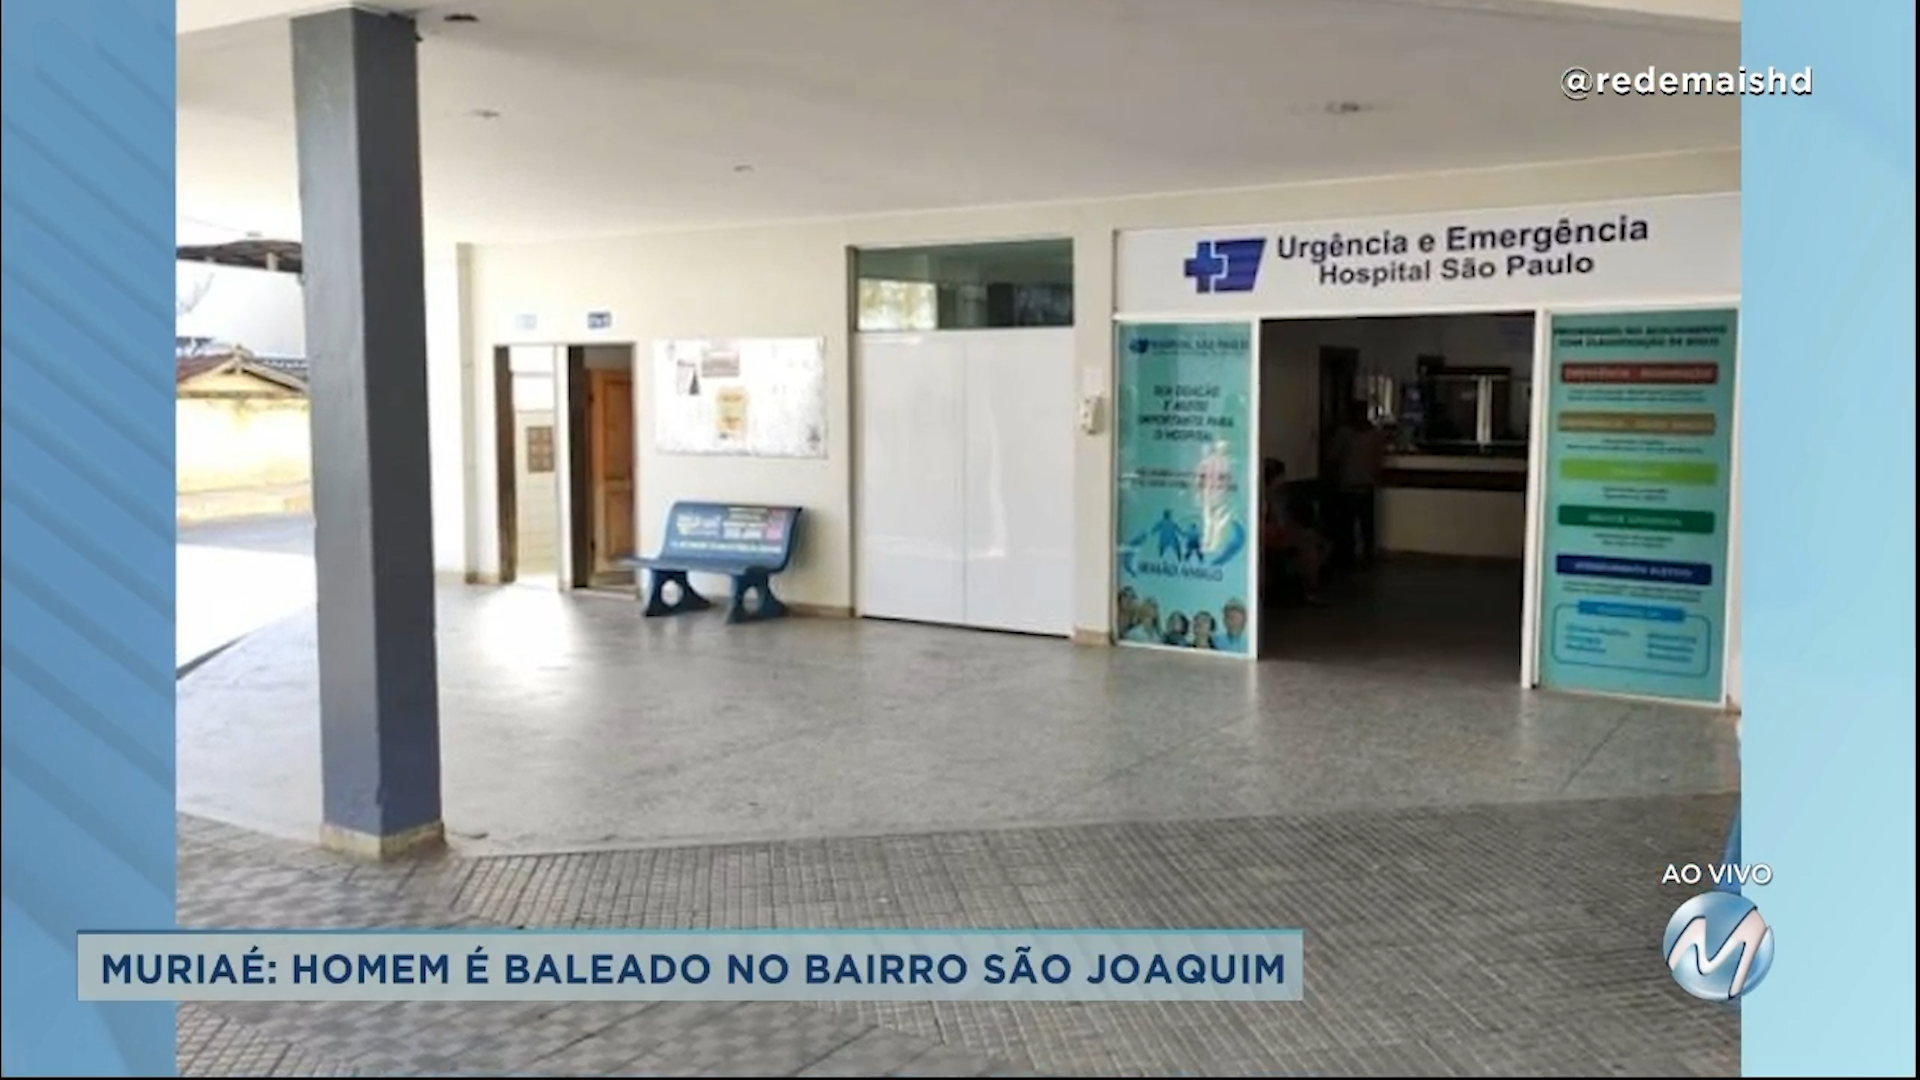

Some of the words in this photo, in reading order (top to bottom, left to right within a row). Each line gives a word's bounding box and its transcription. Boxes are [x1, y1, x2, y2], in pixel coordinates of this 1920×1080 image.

[1276, 231, 1409, 263] Urgência
[1418, 234, 1436, 253] e
[1446, 215, 1649, 253] Emergência
[1318, 260, 1432, 287] Hospital
[1440, 254, 1497, 279] São
[1507, 253, 1595, 277] Paulo
